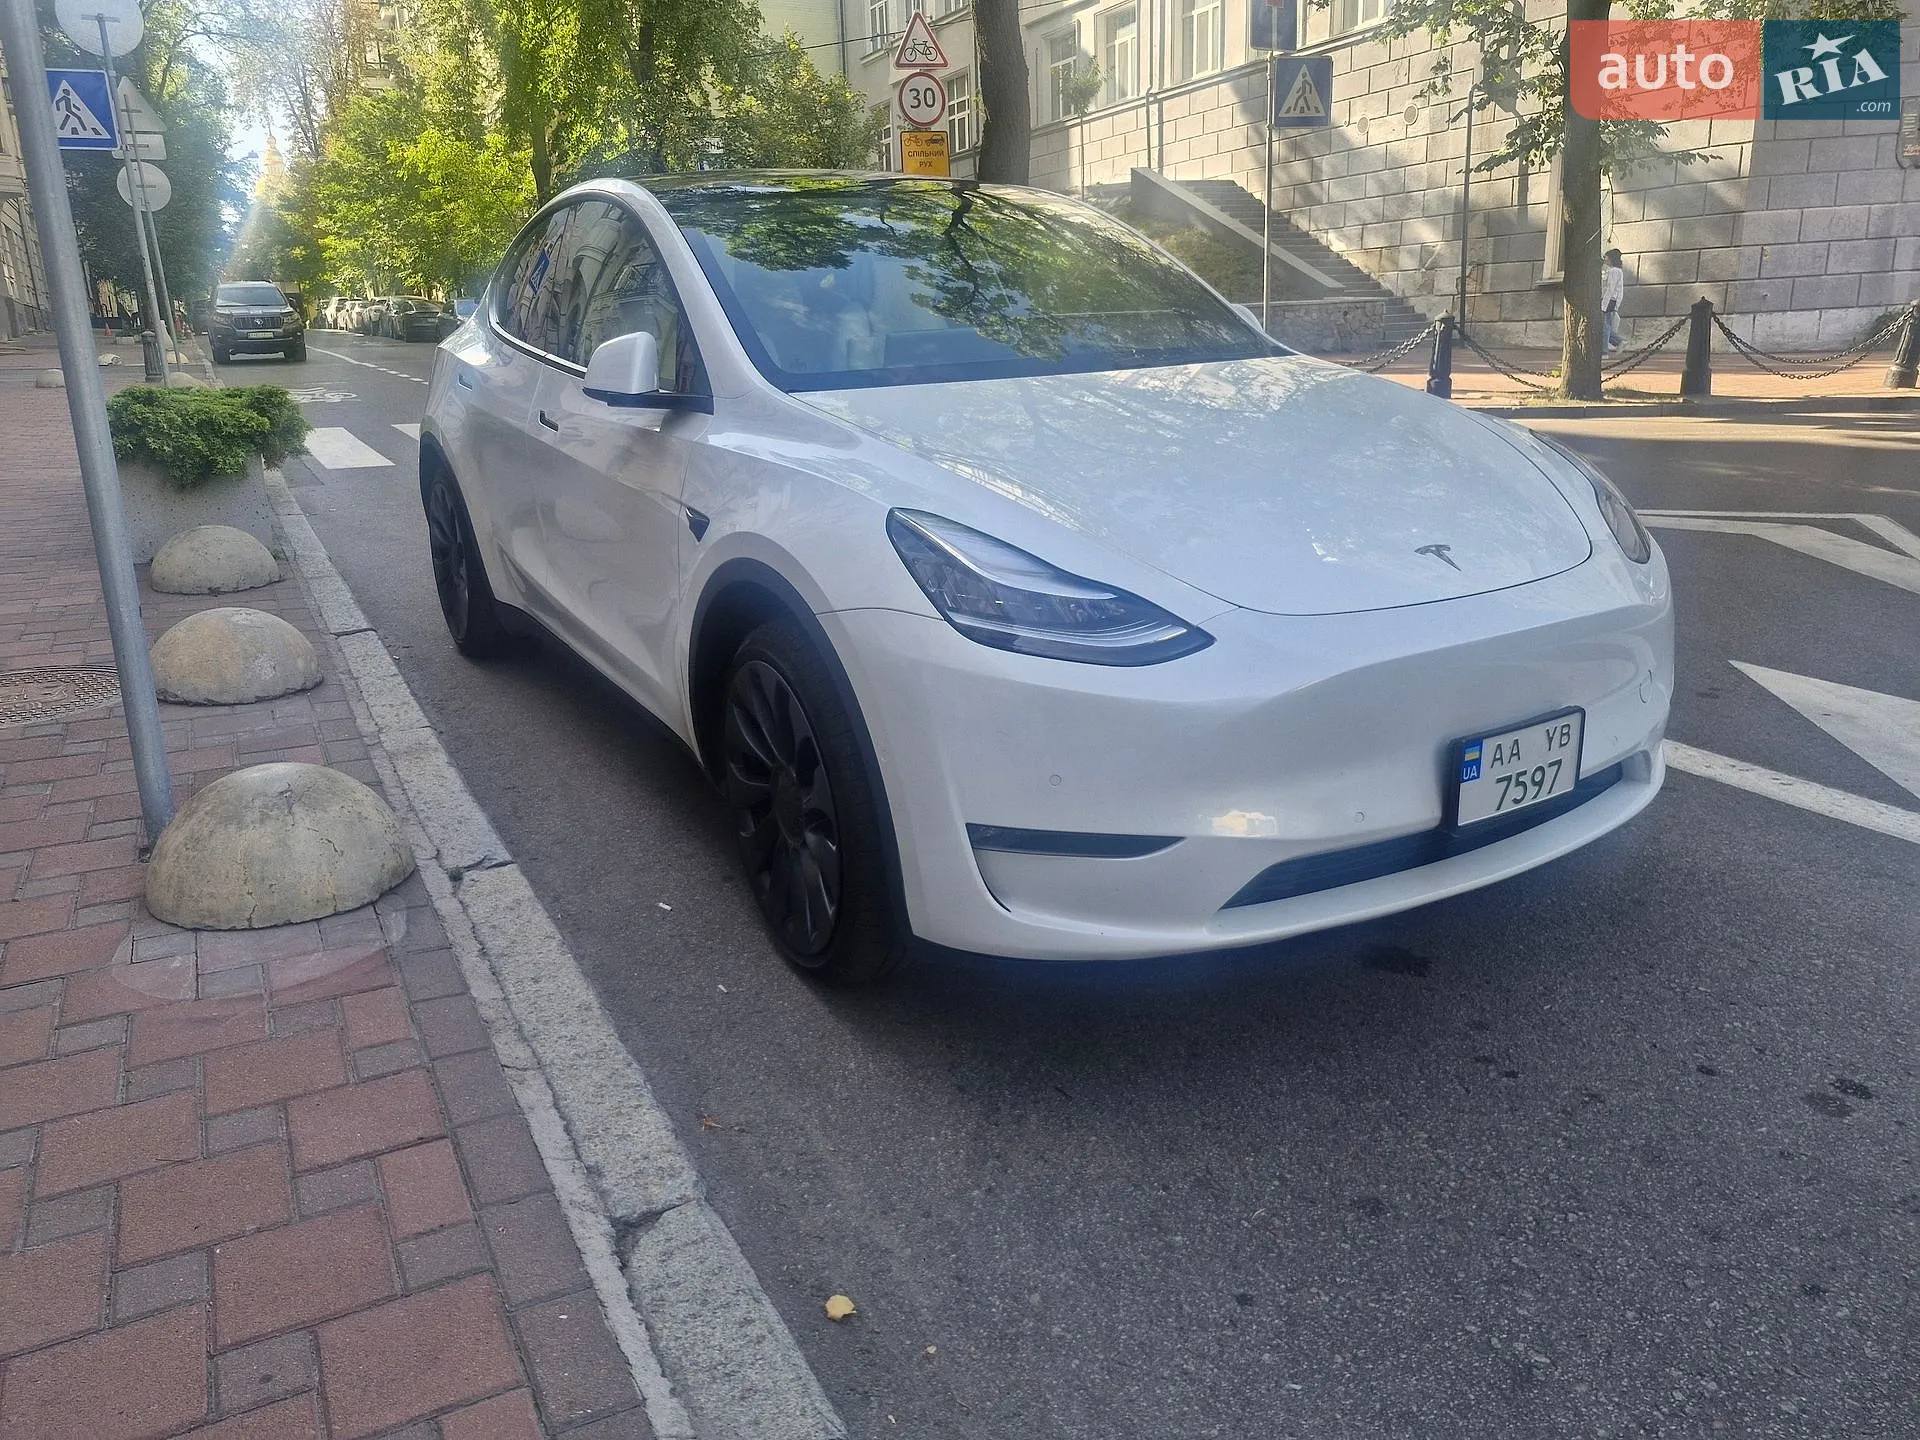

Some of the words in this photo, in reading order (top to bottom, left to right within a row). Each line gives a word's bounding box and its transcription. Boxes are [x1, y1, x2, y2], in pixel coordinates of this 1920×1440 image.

[909, 87, 936, 109] 30
[908, 149, 945, 158] СПІЛЬНИЙ
[1490, 738, 1521, 769] AA
[1546, 723, 1571, 751] YB
[1462, 765, 1478, 780] UA
[1495, 758, 1563, 811] 7597
